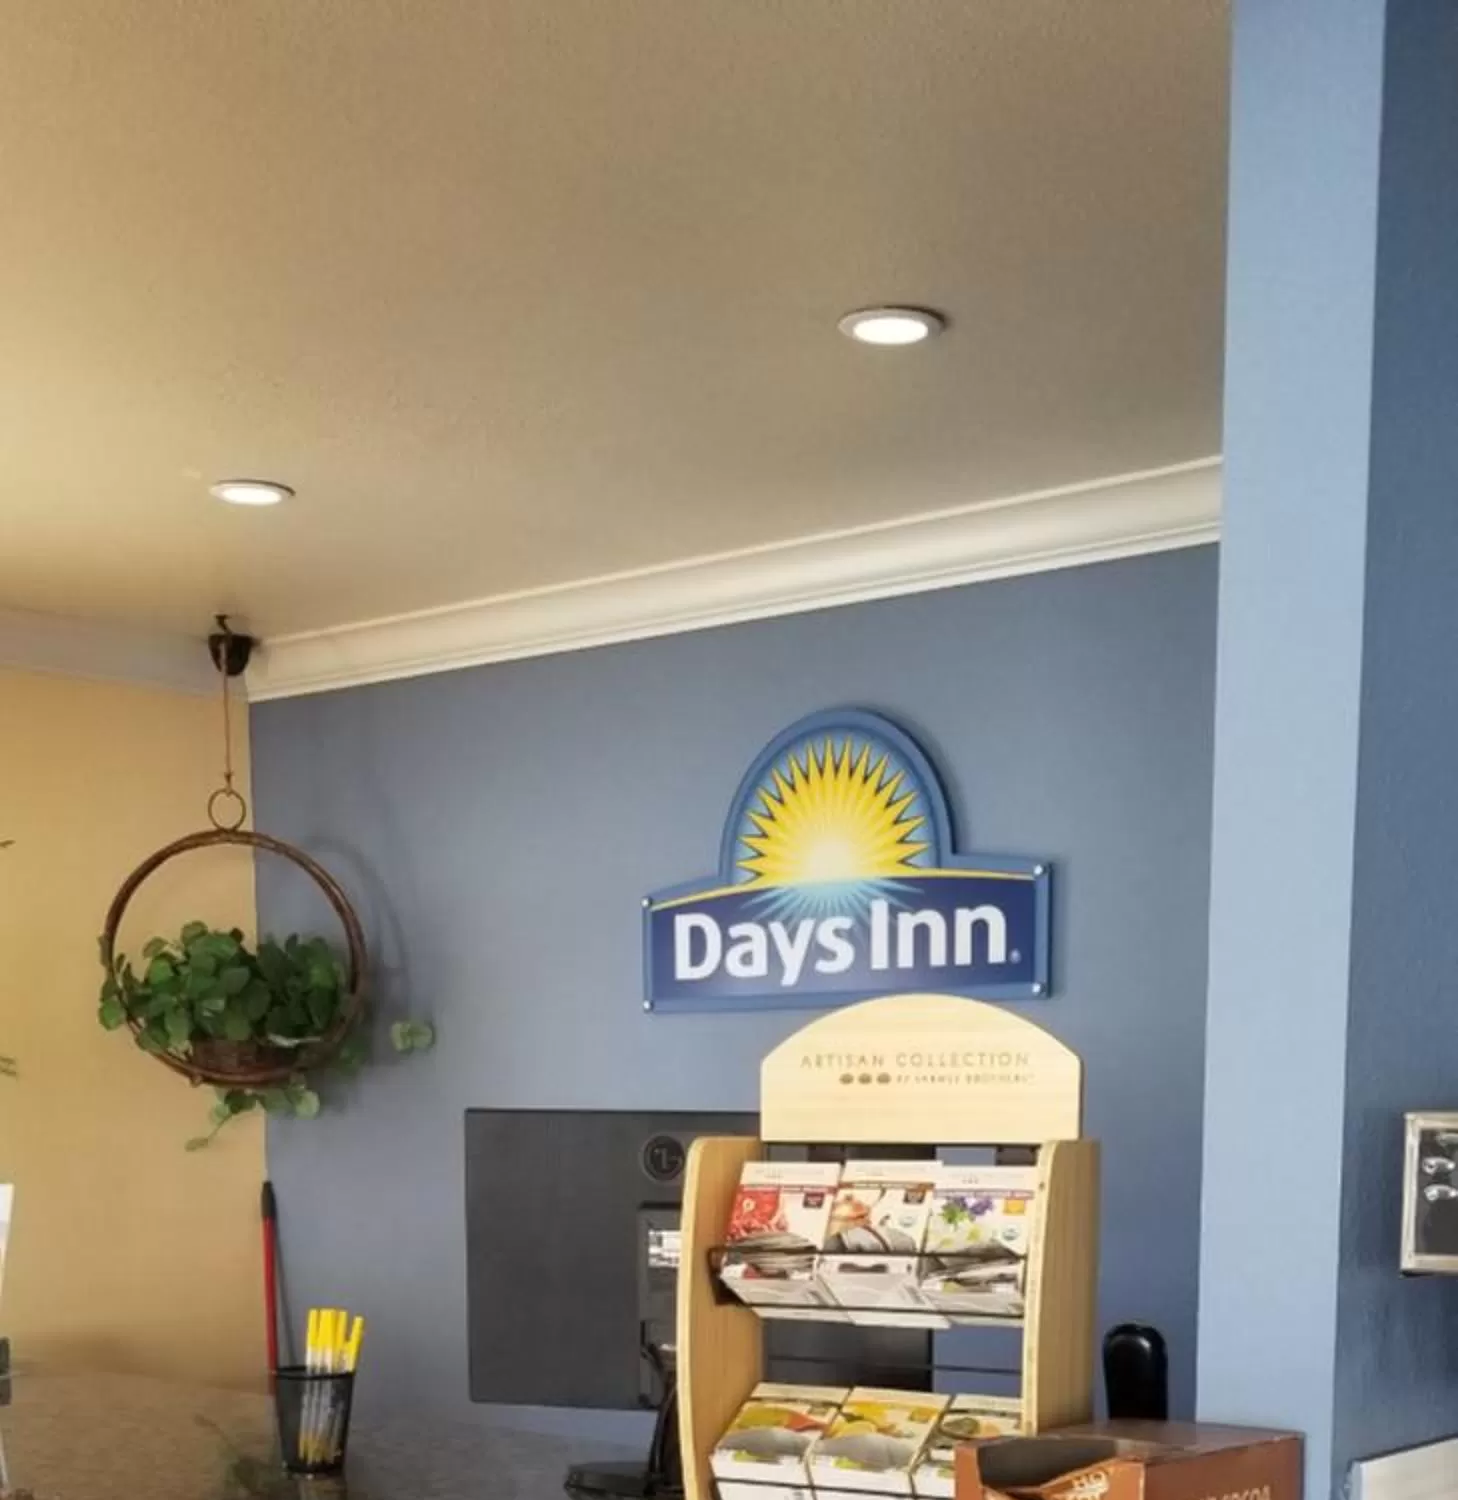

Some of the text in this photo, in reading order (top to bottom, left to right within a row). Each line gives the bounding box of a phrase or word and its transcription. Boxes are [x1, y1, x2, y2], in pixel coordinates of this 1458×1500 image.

[673, 898, 1008, 986] Days Inn
[800, 1051, 1030, 1069] ARTISAN COLLECTION
